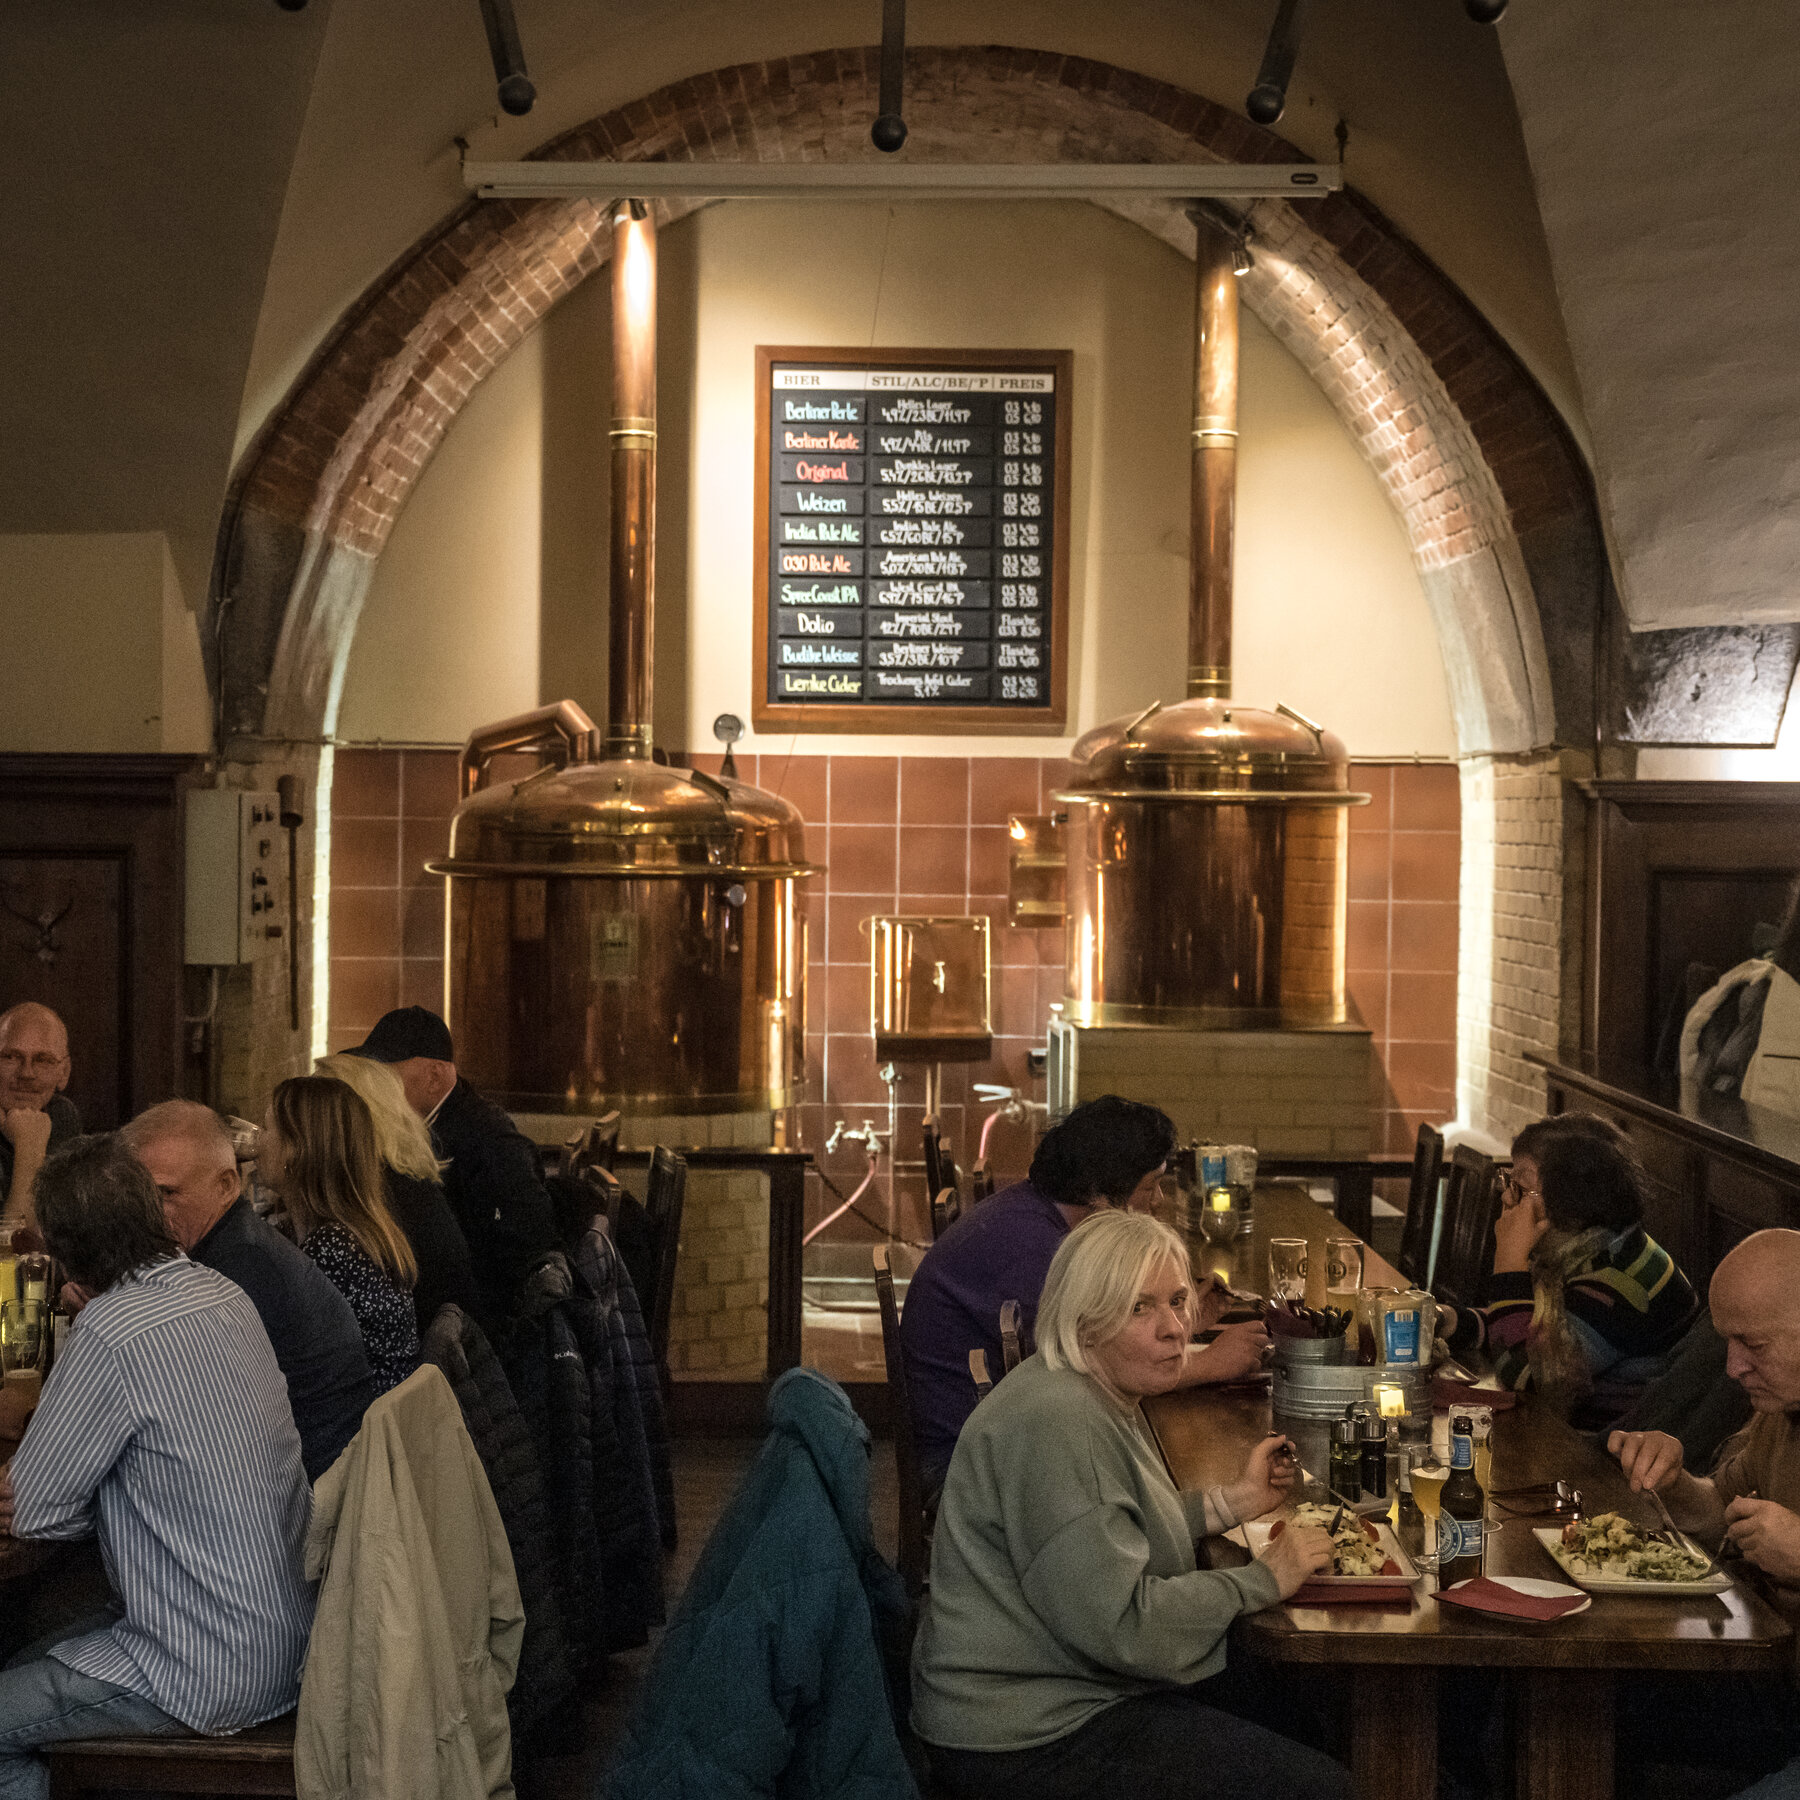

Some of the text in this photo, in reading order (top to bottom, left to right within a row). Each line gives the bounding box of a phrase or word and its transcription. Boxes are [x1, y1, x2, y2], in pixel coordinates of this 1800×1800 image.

[783, 376, 821, 386] BIER
[999, 378, 1045, 390] PREIS
[796, 460, 849, 483] Original
[796, 491, 848, 512] Weizen
[784, 522, 818, 541] India
[783, 554, 808, 572] 030
[797, 612, 835, 634] Dolio
[828, 674, 862, 693] Cider
